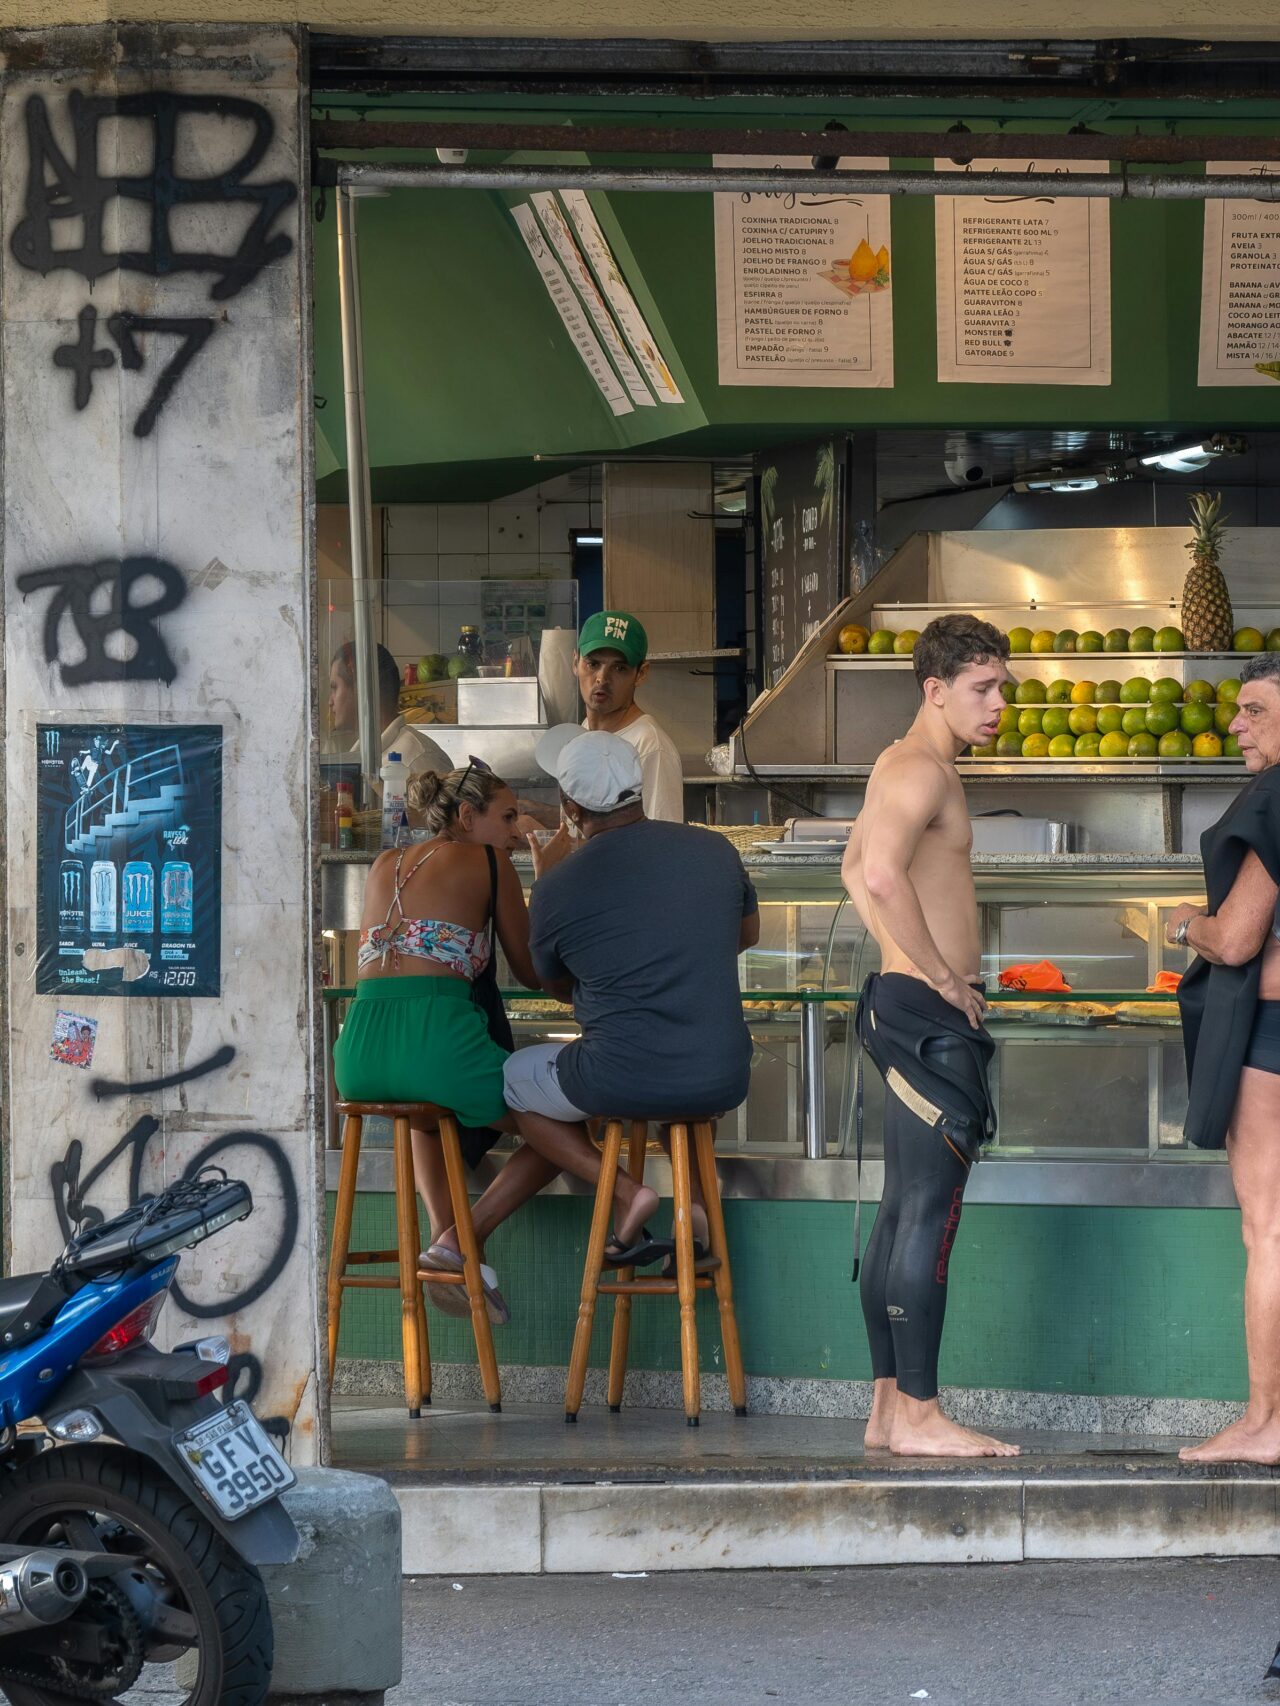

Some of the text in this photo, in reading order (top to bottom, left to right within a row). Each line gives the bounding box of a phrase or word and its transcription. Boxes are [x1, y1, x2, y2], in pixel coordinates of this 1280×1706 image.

[779, 217, 832, 225] TRADICIONAL
[1232, 213, 1257, 221] 300ml
[963, 247, 1013, 255] ÁGUA GÁS
[963, 257, 985, 265] ÁGUA
[996, 257, 1013, 265] GÁS
[963, 267, 985, 275] ÁGUA
[992, 288, 1012, 296] LEÃO
[744, 307, 800, 315] HAMBÚRGUER
[1227, 341, 1257, 349] MAMÃO
[745, 354, 786, 362] PASTELÃO
[75, 974, 100, 984] Beast!
[936, 1186, 962, 1283] reaction
[200, 1426, 260, 1479] GFV
[217, 1454, 285, 1509] 3950
